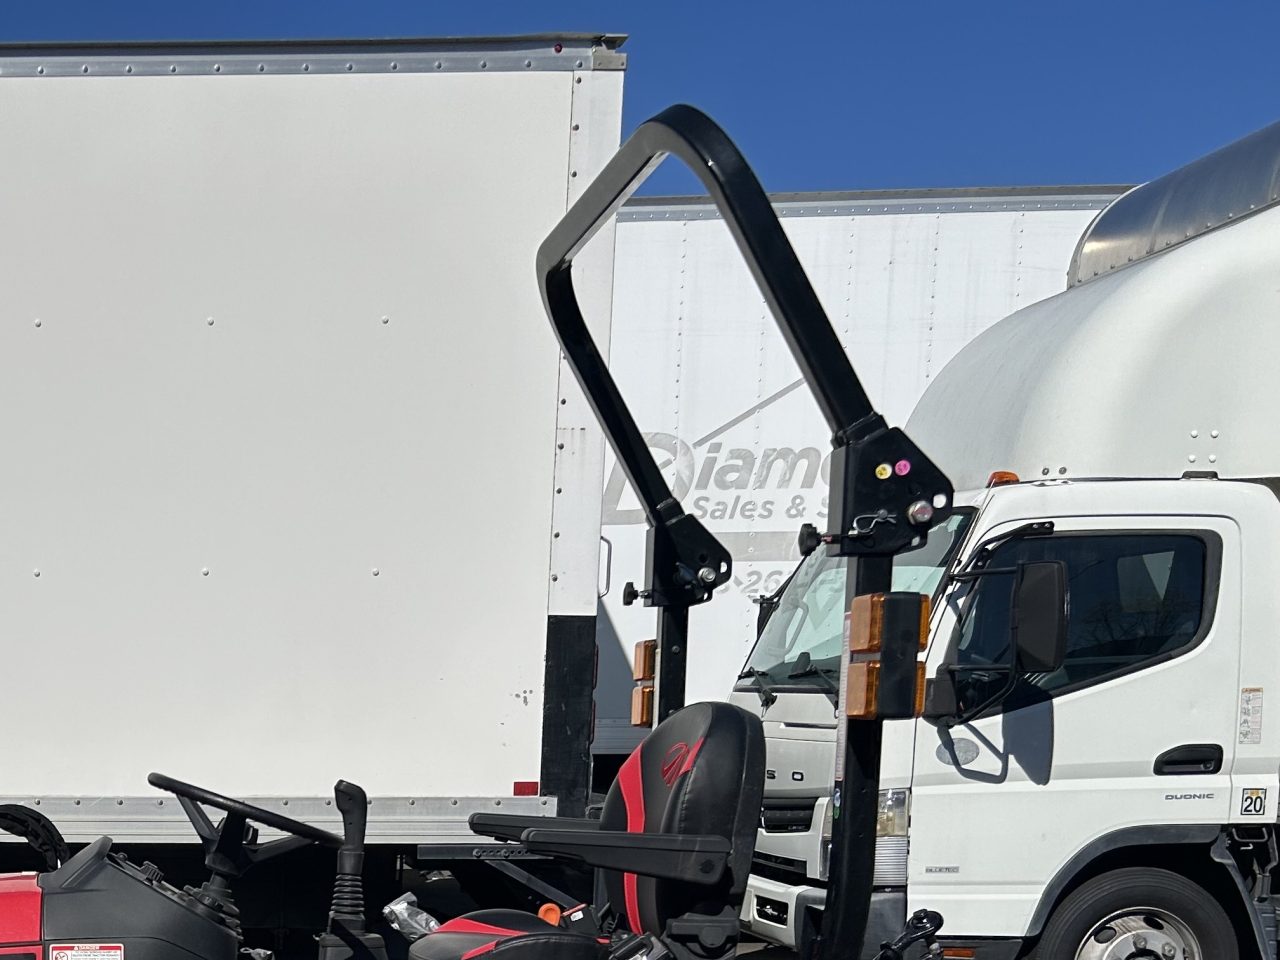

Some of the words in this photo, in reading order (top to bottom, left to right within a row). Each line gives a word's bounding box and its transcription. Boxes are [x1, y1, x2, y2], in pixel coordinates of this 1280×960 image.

[602, 432, 830, 525] Diam
[692, 495, 775, 520] Sales
[785, 495, 806, 519] &
[1243, 796, 1263, 813] 20
